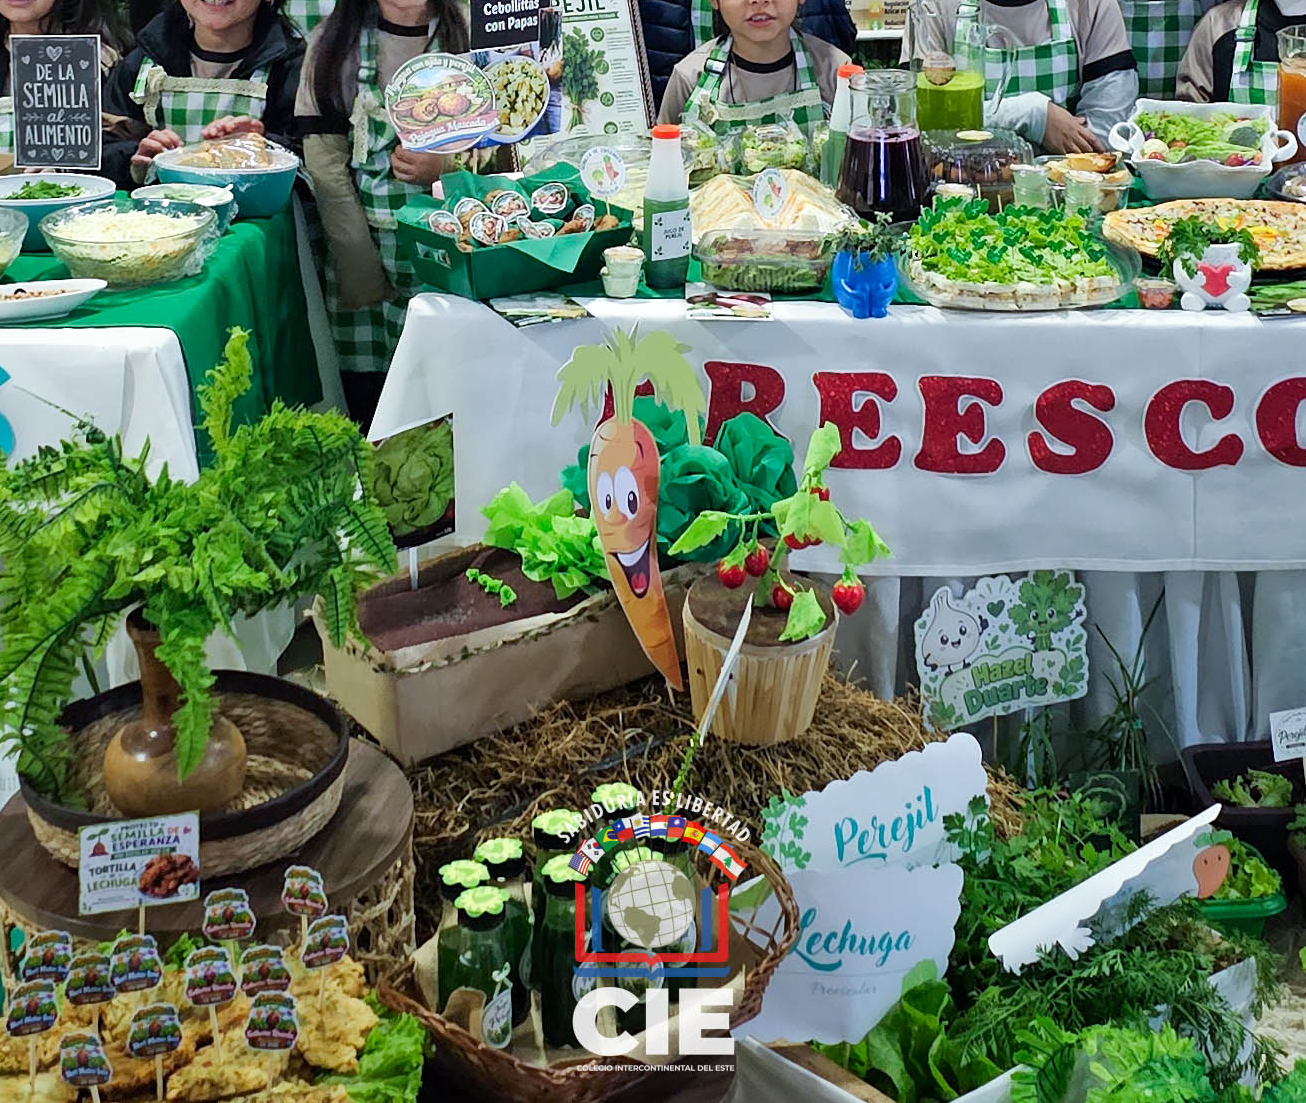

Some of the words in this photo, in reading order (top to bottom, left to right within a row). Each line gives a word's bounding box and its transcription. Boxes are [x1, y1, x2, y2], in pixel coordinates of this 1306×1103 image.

[484, 19, 506, 33] con
[507, 14, 539, 32] Papas
[36, 63, 53, 81] DE
[58, 63, 75, 81] LA
[22, 81, 89, 109] SEMILLA
[46, 108, 66, 122] al
[25, 124, 92, 146] ALIMENTO
[970, 652, 1035, 689] Hazel
[963, 675, 1049, 716] Duarte
[834, 785, 939, 863] Perejil
[110, 827, 165, 842] SEMILLA
[112, 835, 181, 852] ESPERANZA
[88, 862, 137, 877] TORTILLA
[86, 878, 139, 893] LECHUGA
[786, 907, 916, 972] Lechuga
